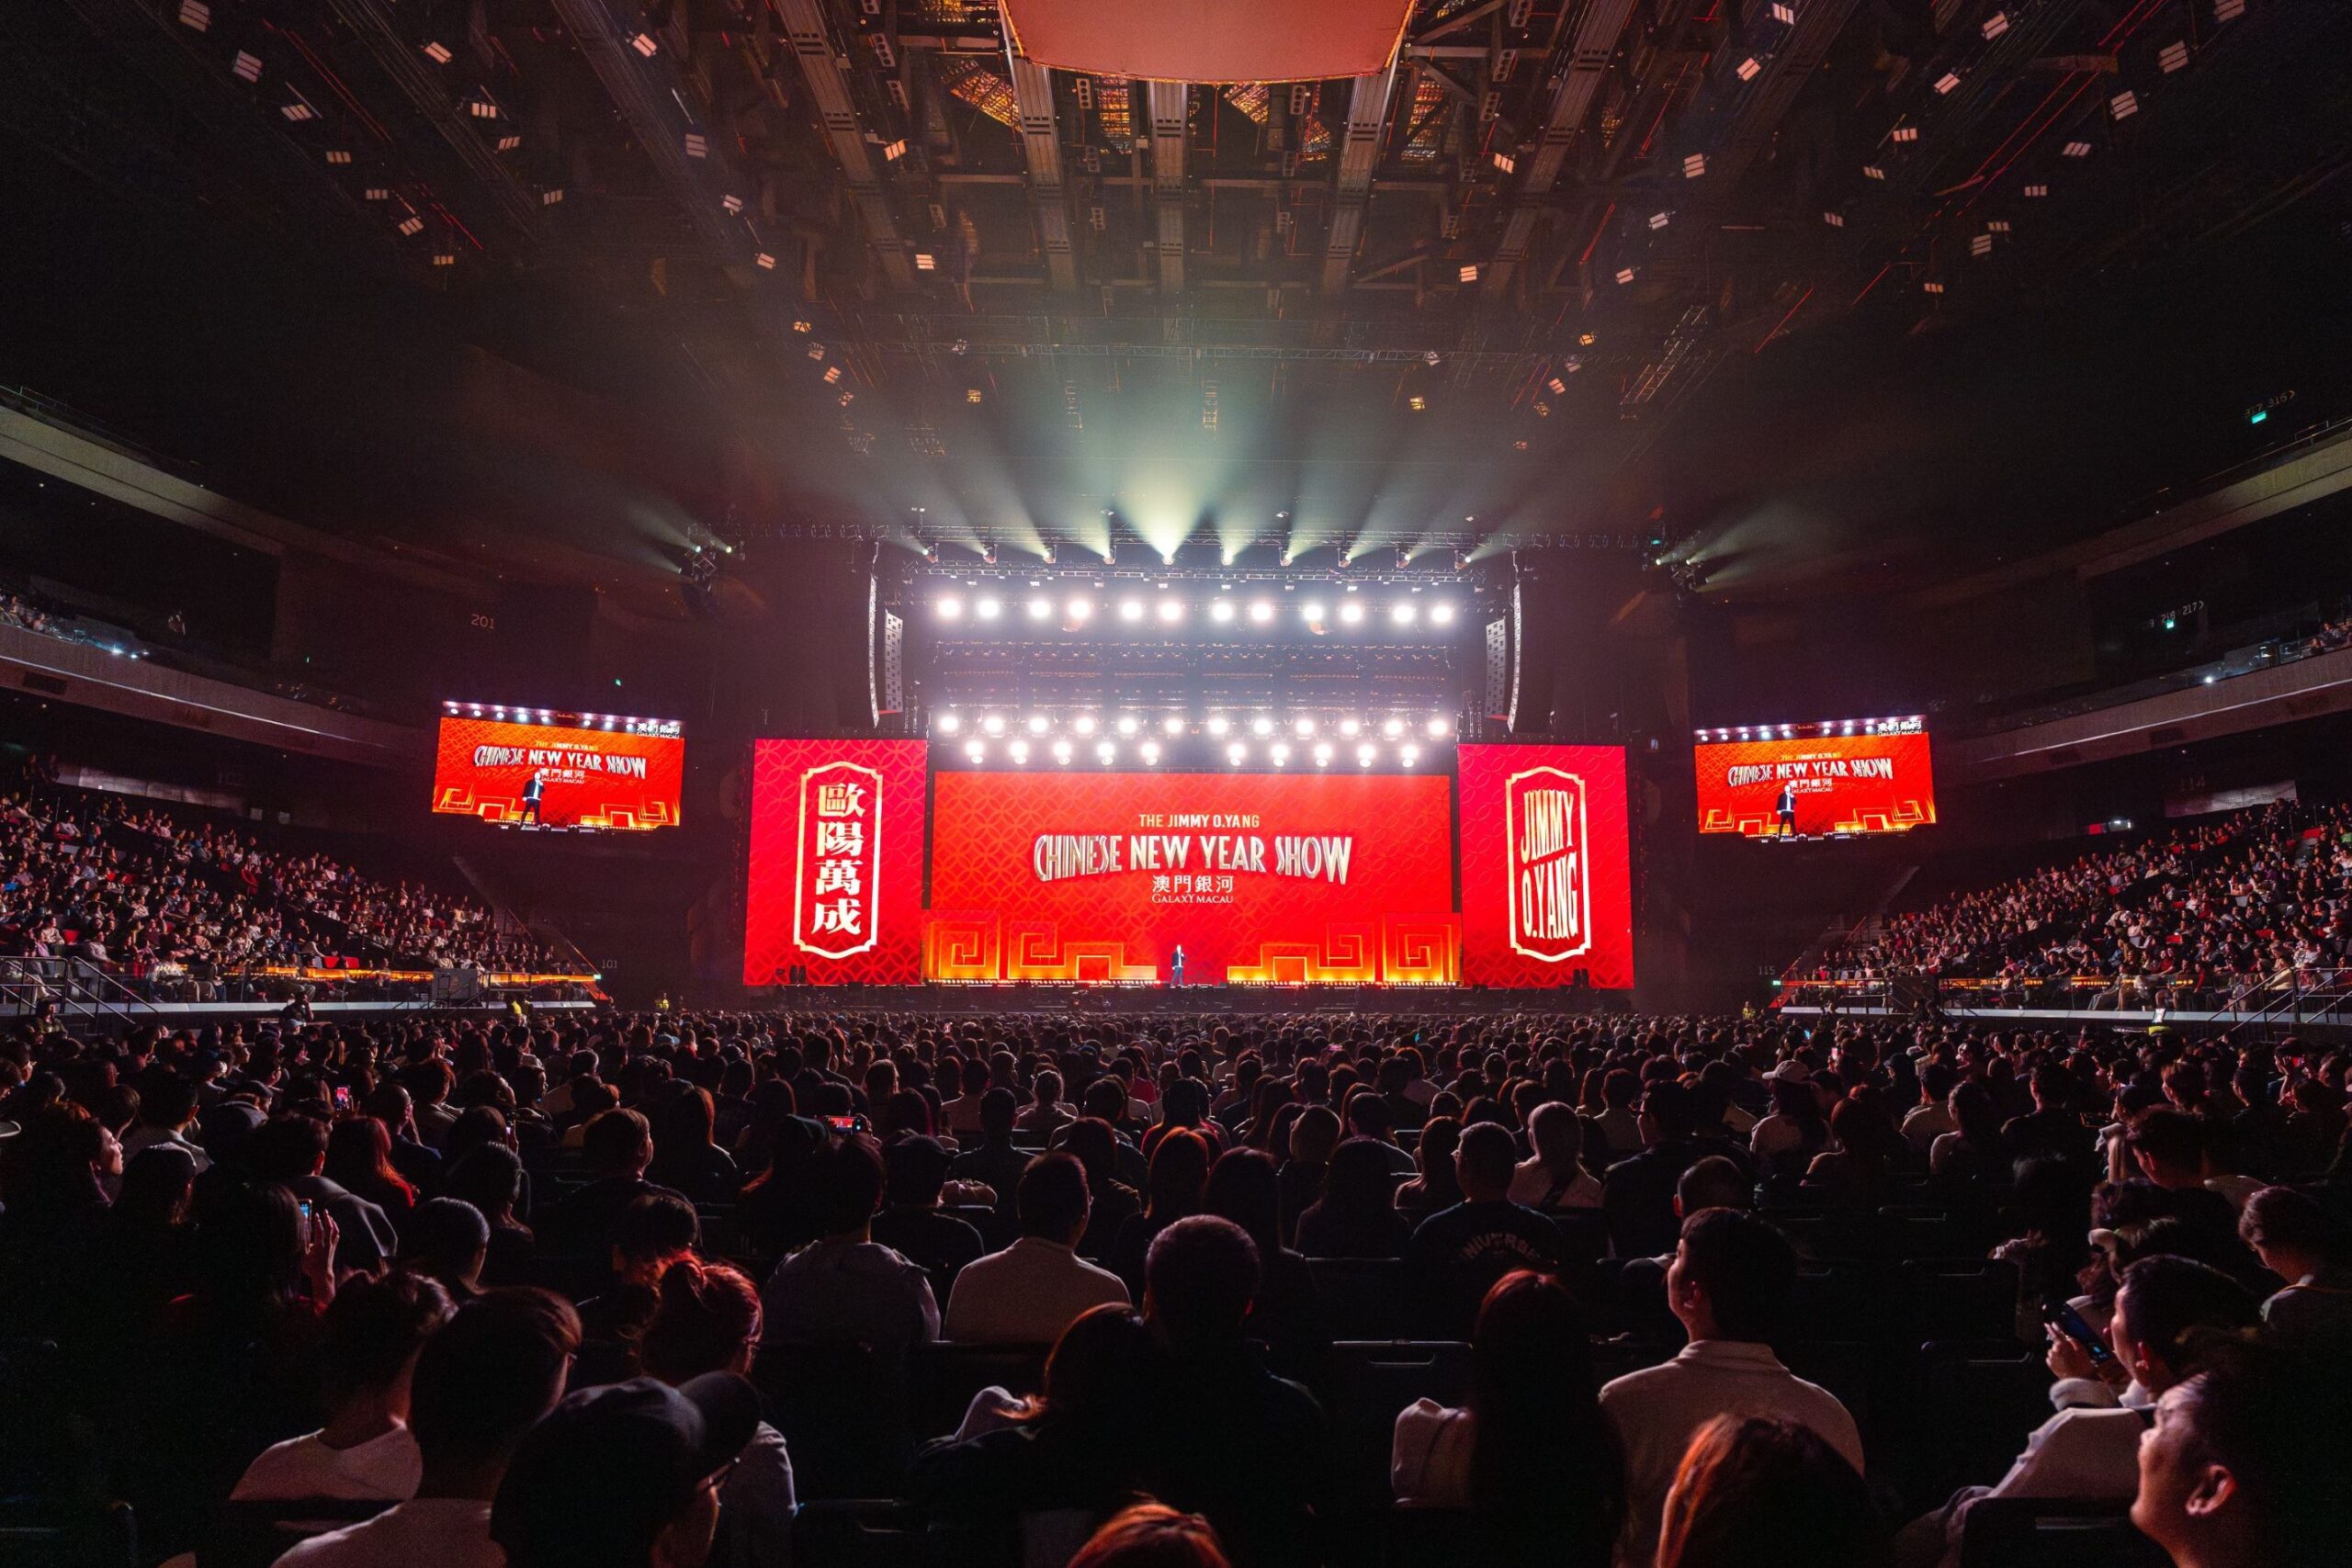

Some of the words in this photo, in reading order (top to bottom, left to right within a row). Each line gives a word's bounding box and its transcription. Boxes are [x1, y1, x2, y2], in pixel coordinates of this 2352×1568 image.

[2182, 602, 2198, 615] 217
[470, 613, 494, 629] 201
[472, 745, 526, 767] CHINESE
[527, 749, 562, 766] NEW
[567, 751, 603, 771] YEAR
[606, 755, 647, 779] SHOW
[1728, 763, 1773, 786] CHINESE
[1776, 761, 1807, 779] NEW
[1812, 760, 1849, 777] YEAR
[1850, 758, 1893, 780] SHOW
[1139, 814, 1163, 828] THE
[1168, 814, 1209, 828] JIMMY
[1213, 815, 1260, 828] O.YANG
[1521, 788, 1574, 864] JIMMY
[811, 783, 866, 935] 歐陽萬成
[1034, 834, 1123, 882] CHINESE
[1130, 835, 1191, 871] NEW
[1199, 835, 1266, 873] YEAR
[1275, 835, 1352, 886] SHOW
[1152, 875, 1234, 893] 澳門銀河
[1152, 894, 1195, 904] GALAXY
[1196, 895, 1233, 904] MACAU
[1521, 851, 1578, 940] O.YANG
[602, 959, 617, 969] 101
[1758, 964, 1776, 976] 115
